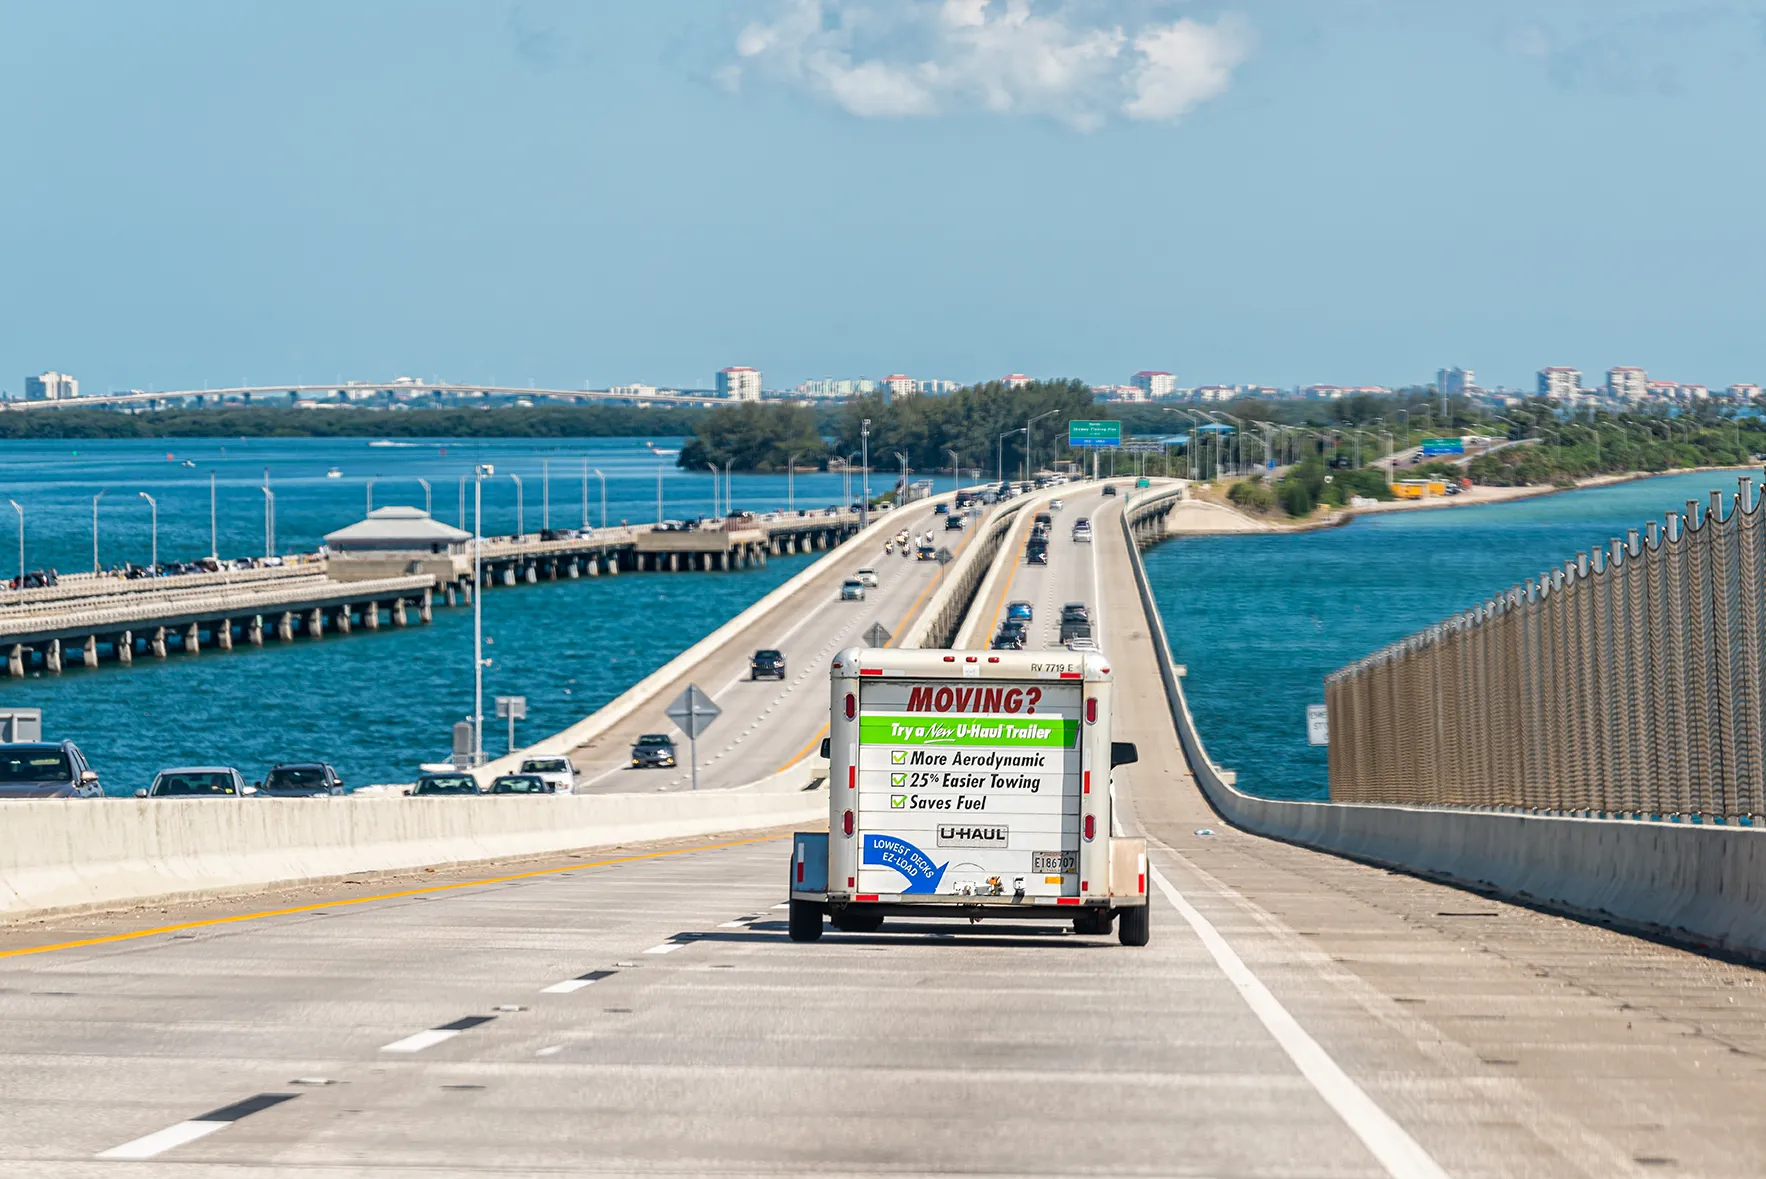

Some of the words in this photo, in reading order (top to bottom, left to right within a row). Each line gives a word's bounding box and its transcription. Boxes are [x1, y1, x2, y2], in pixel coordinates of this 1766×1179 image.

[1031, 664, 1043, 672] RV
[1045, 664, 1065, 672] 7719
[1067, 664, 1074, 672] E
[906, 686, 1042, 714] MOVING?
[891, 723, 915, 741] Try
[915, 727, 924, 737] a
[924, 722, 956, 739] New
[956, 724, 1003, 739] U-Haul
[1006, 724, 1052, 739] Trailer
[910, 751, 947, 766] More
[952, 752, 1045, 768] Aerodynamic
[910, 773, 939, 788] 25%
[942, 774, 986, 789] Easier
[990, 774, 1041, 793] Towing
[909, 795, 952, 810] Saves
[956, 795, 987, 811] Fuel
[941, 827, 1006, 840] U-HAUL
[873, 839, 911, 856] LOWEST
[910, 852, 934, 879] DECKS
[882, 852, 918, 877] EZ-LOAD
[1035, 857, 1075, 868] E186707
